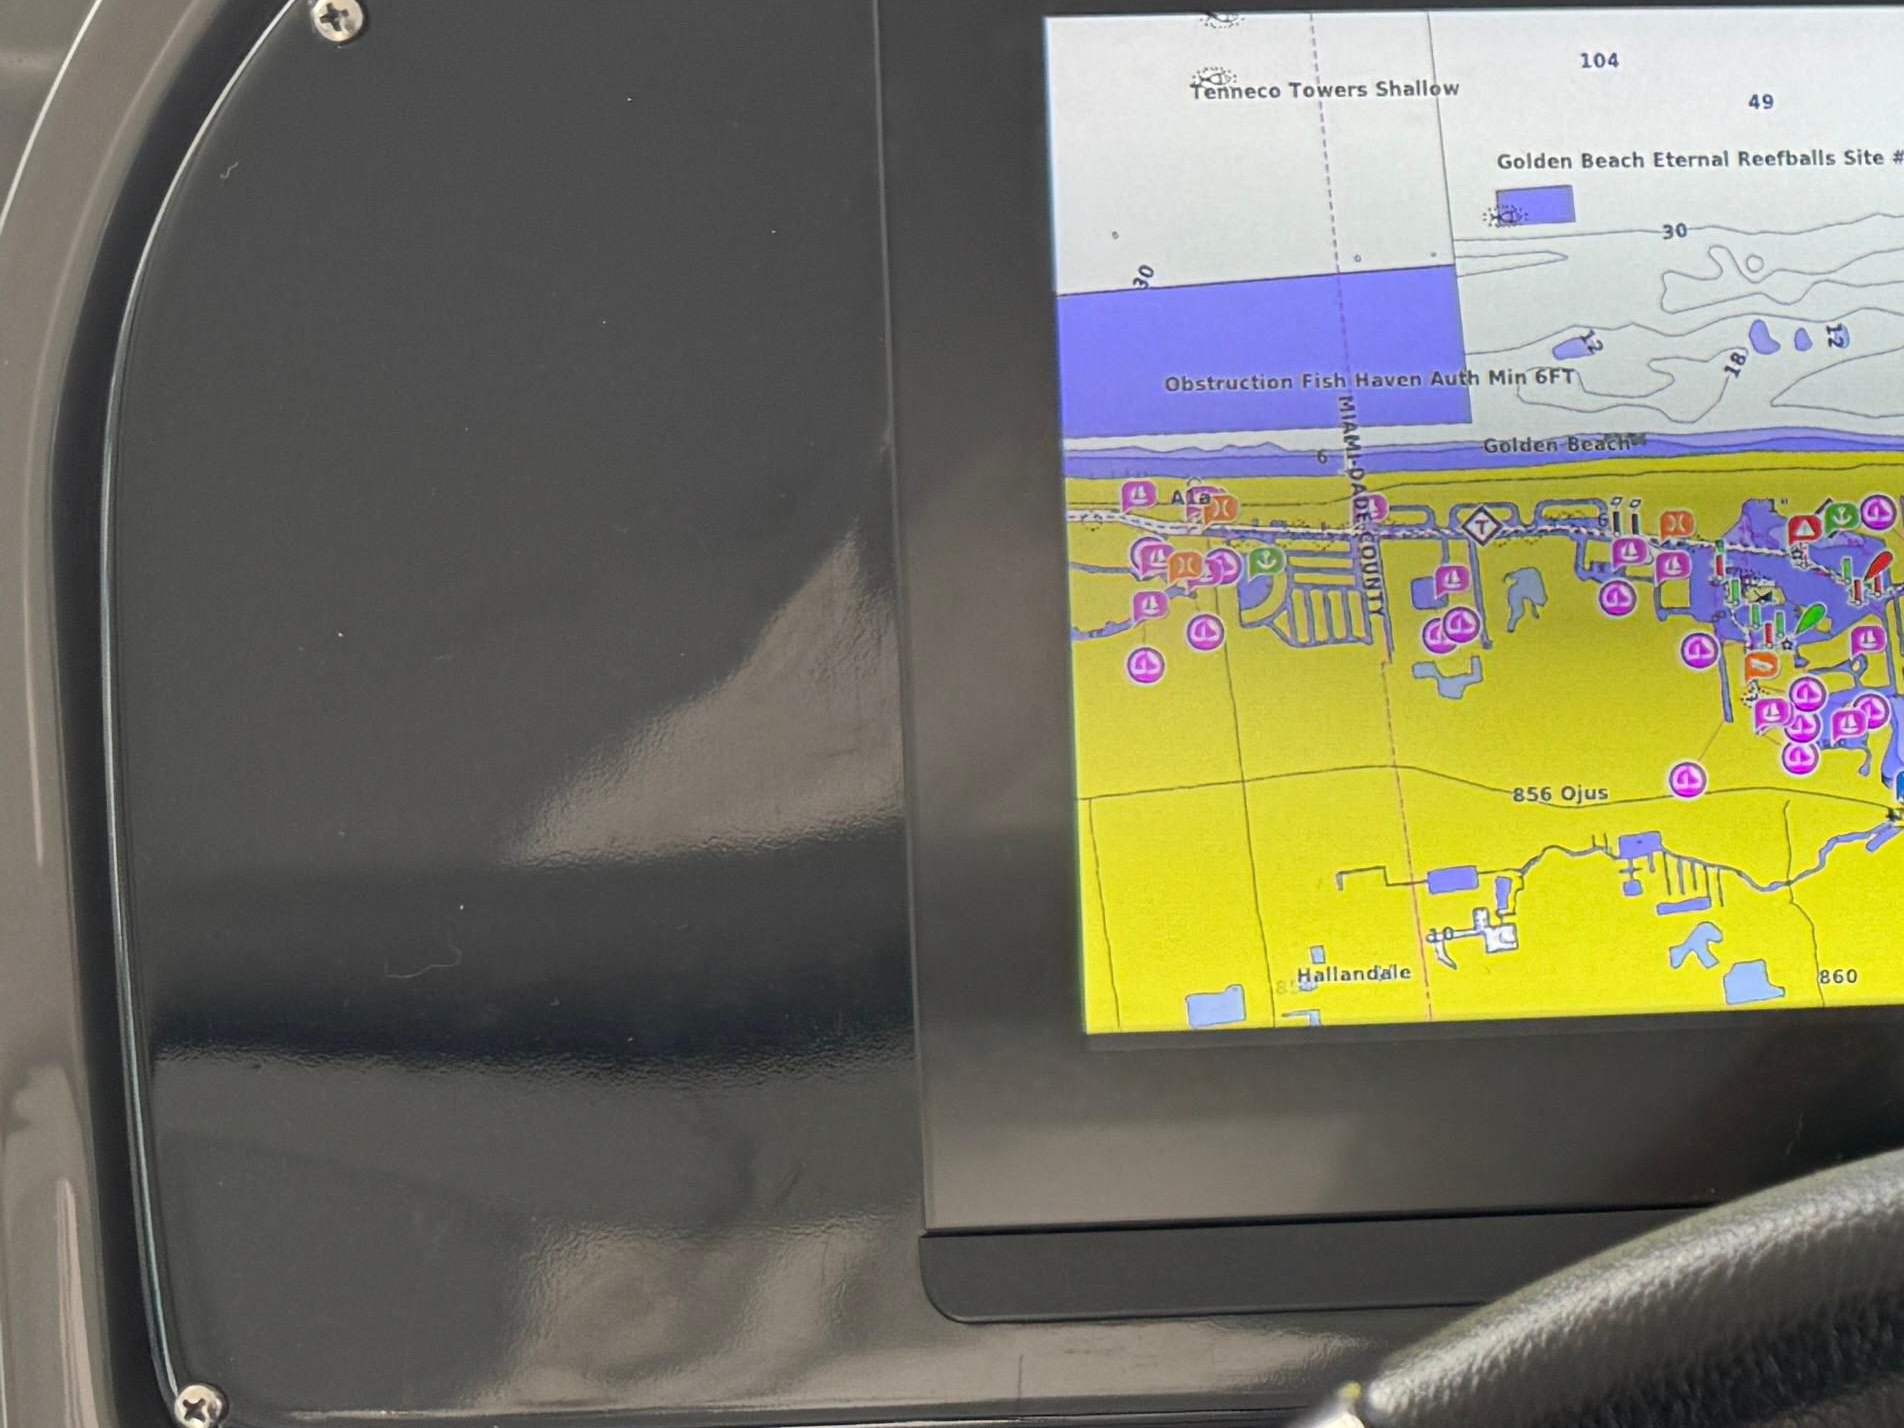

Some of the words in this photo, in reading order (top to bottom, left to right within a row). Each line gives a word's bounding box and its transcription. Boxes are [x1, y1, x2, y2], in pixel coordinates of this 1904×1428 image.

[1580, 52, 1620, 69] 104
[1191, 82, 1281, 100] Tenneco
[1288, 81, 1368, 98] Towers
[1376, 79, 1460, 97] Shallow
[1748, 94, 1774, 109] 49
[1497, 152, 1573, 170] Golden
[1581, 151, 1645, 169] Beach
[1653, 150, 1729, 168] Eternal
[1738, 149, 1836, 167] Reefballs
[1843, 149, 1884, 166] Site
[1662, 223, 1688, 240] 30
[1132, 264, 1155, 289] 30
[1165, 375, 1293, 393] Obstruction
[1301, 372, 1346, 390] Fish
[1355, 372, 1421, 389] Haven
[1430, 369, 1480, 387] Auth
[1488, 369, 1527, 386] Min
[1536, 368, 1575, 385] 6FT
[1484, 437, 1558, 453] Golden
[1567, 435, 1631, 452] Beach
[1512, 786, 1552, 803] 856
[1561, 784, 1609, 804] Ojus
[1298, 964, 1412, 983] Hallandale
[1819, 969, 1858, 985] 860
